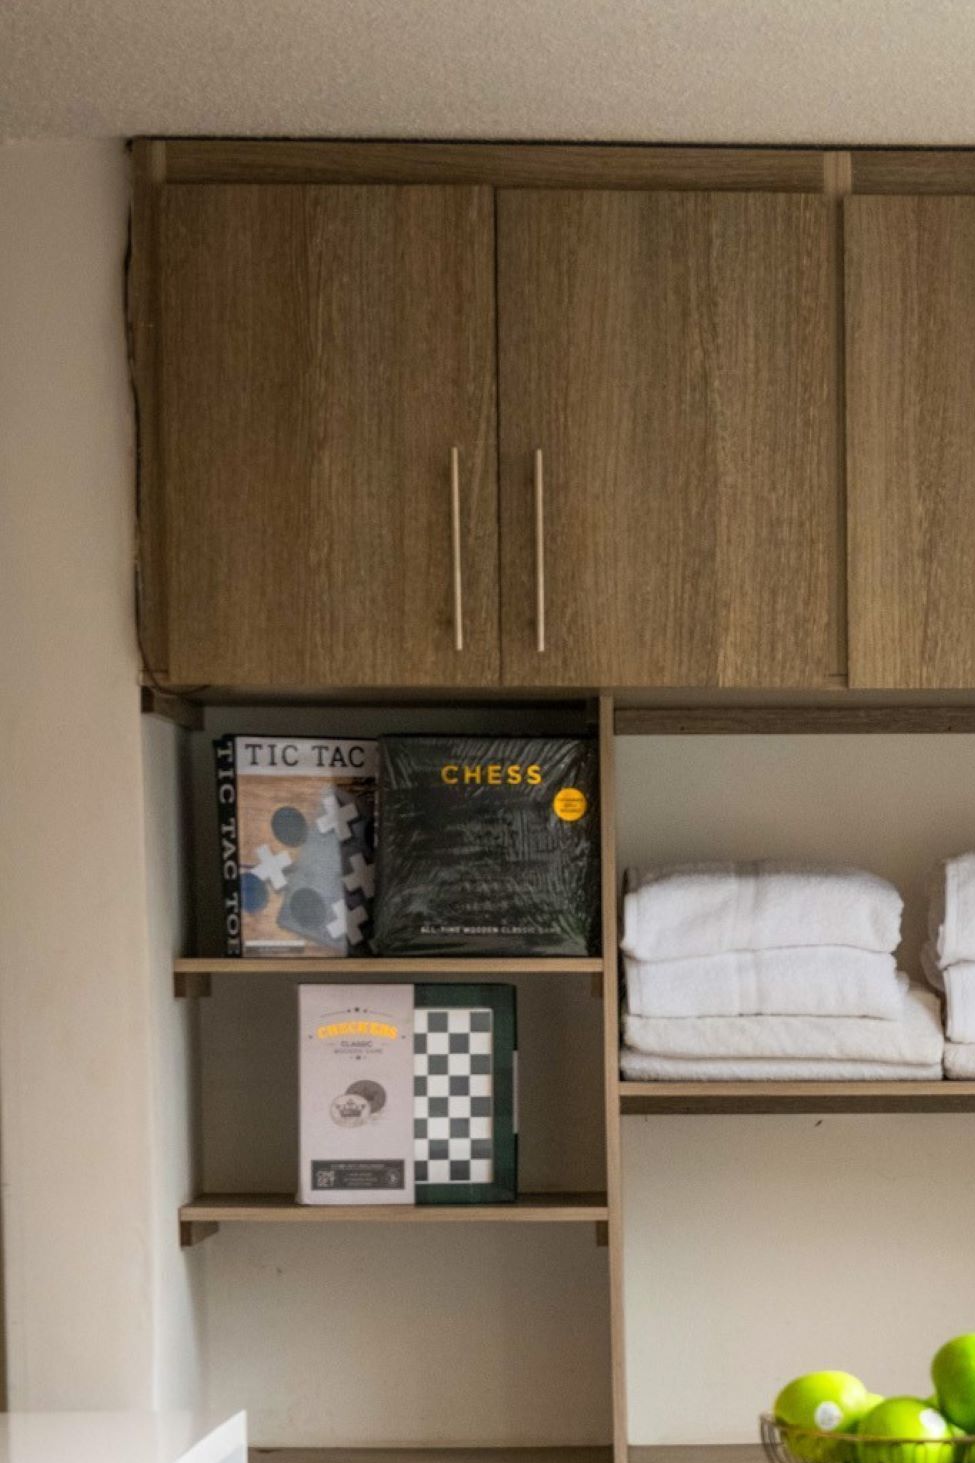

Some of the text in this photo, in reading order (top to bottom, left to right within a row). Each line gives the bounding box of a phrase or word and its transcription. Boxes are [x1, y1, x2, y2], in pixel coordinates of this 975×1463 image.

[217, 741, 235, 804] TIC
[245, 743, 365, 768] TIC TAC
[441, 764, 542, 785] CHESS
[220, 817, 238, 880] TAC
